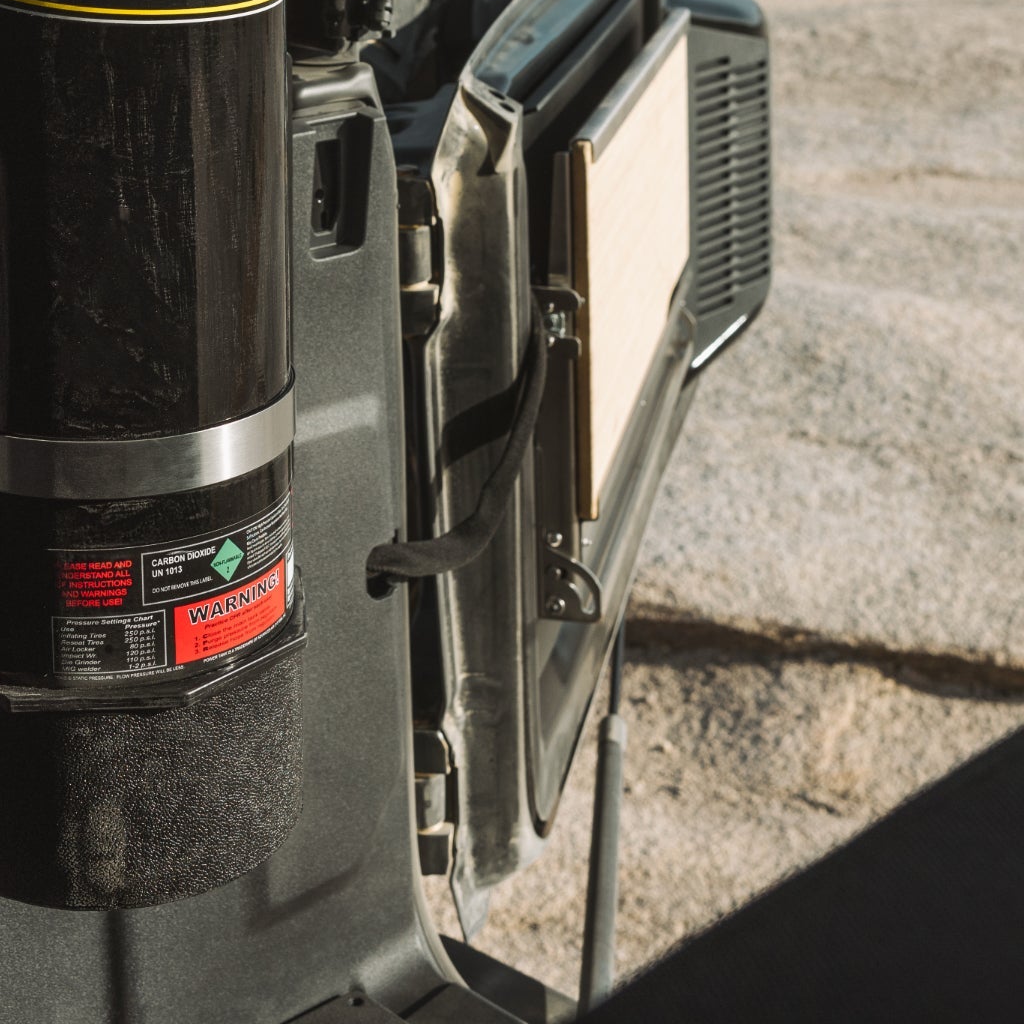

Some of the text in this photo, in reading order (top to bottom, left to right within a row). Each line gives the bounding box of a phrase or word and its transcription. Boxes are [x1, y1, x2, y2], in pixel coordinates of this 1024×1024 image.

[151, 546, 216, 567] CARBON DIOXIDE
[88, 561, 112, 570] READ
[114, 560, 132, 569] AND
[115, 569, 131, 577] ALL
[151, 565, 183, 578] UN 1013
[69, 578, 133, 589] INSTRUCTIONS
[170, 581, 189, 590] REMOVE
[61, 588, 127, 598] AND WARNINGS
[188, 568, 280, 625] WARNING!
[66, 597, 123, 607] BEFORE USE!
[100, 617, 131, 626] Settings
[133, 615, 154, 623] Chart
[124, 636, 139, 644] 250
